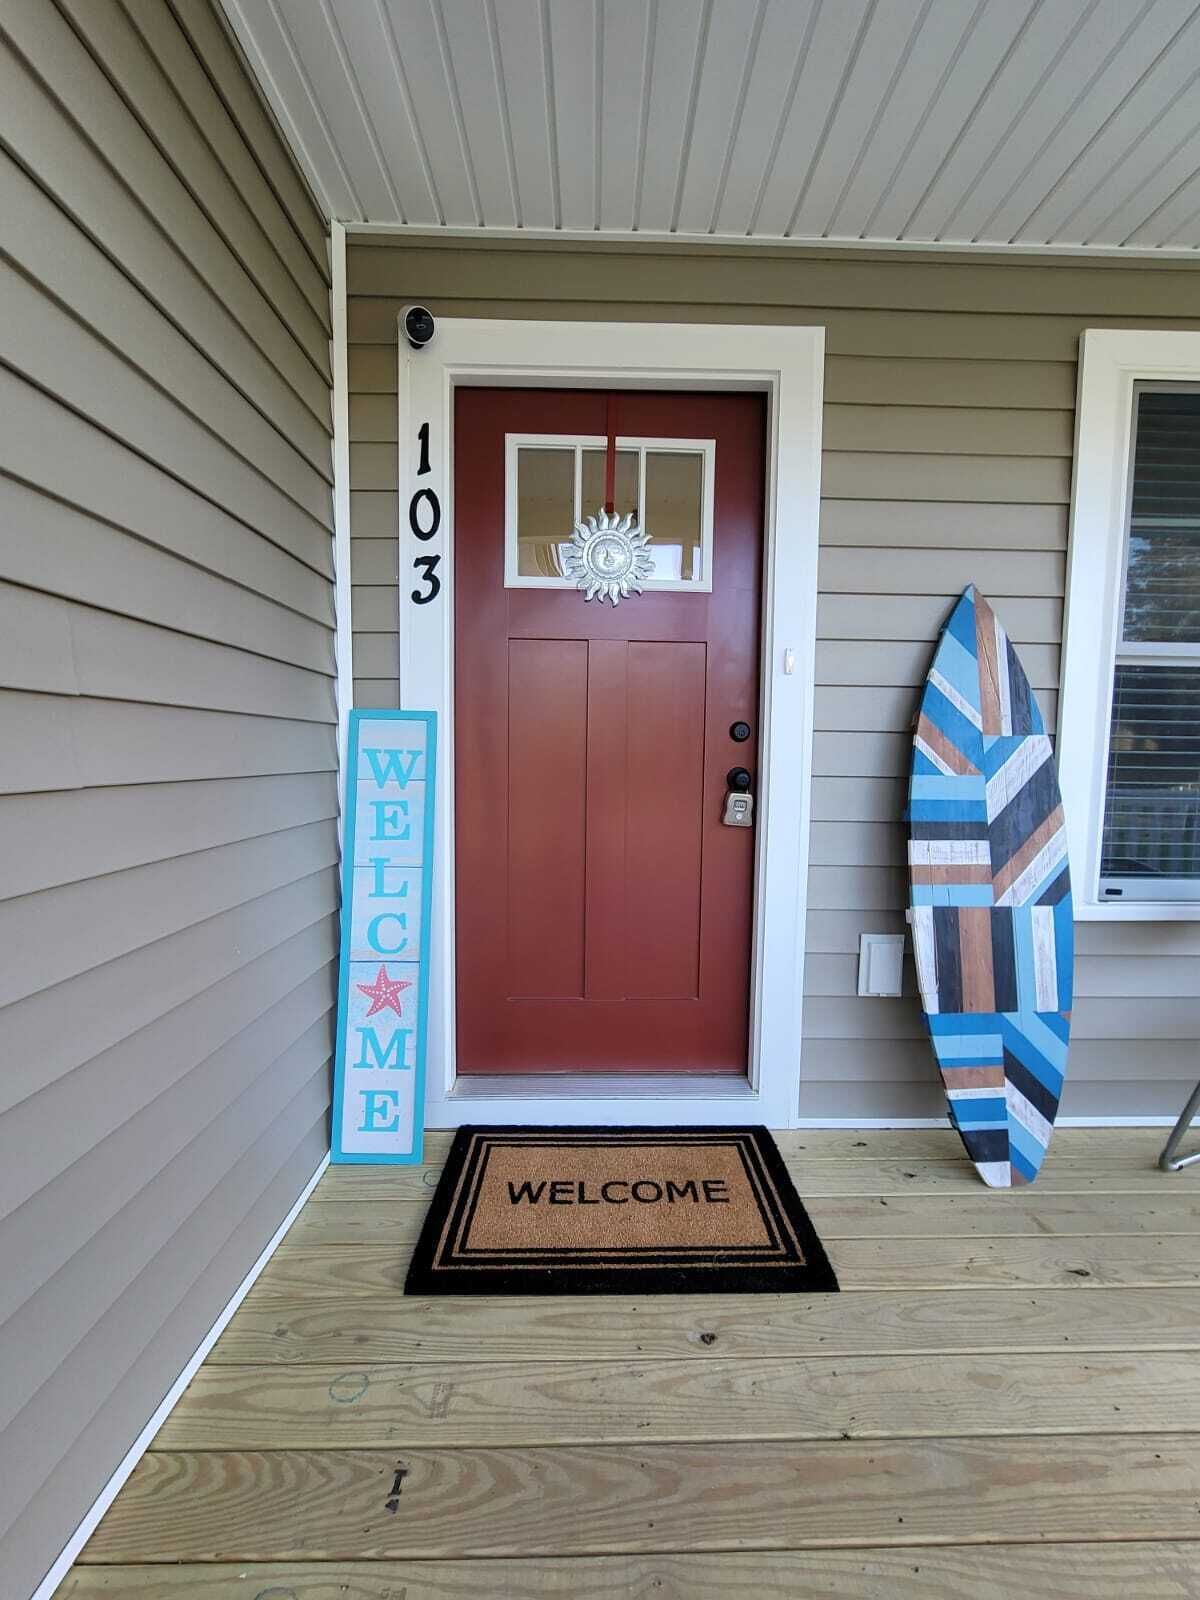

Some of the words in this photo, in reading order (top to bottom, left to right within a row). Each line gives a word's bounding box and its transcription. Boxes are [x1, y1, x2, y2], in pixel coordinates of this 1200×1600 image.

[409, 421, 441, 605] 103
[352, 748, 423, 1132] WELCME
[507, 1179, 731, 1205] WELCOME
